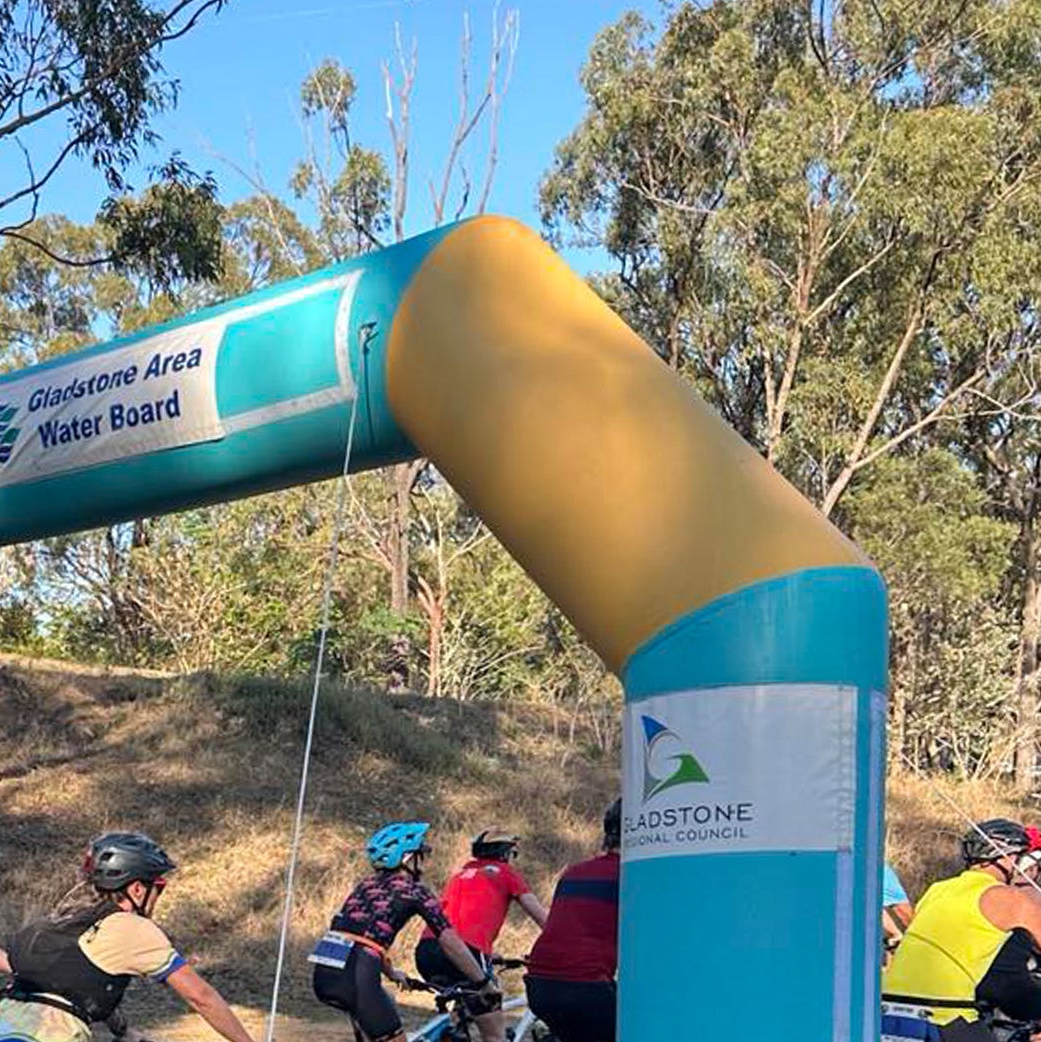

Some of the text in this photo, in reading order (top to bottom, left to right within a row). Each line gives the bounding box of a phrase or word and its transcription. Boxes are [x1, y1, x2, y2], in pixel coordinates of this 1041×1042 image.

[29, 347, 203, 412] Gladstone Area
[38, 389, 181, 448] Water Board
[676, 828, 748, 843] COUNCIL
